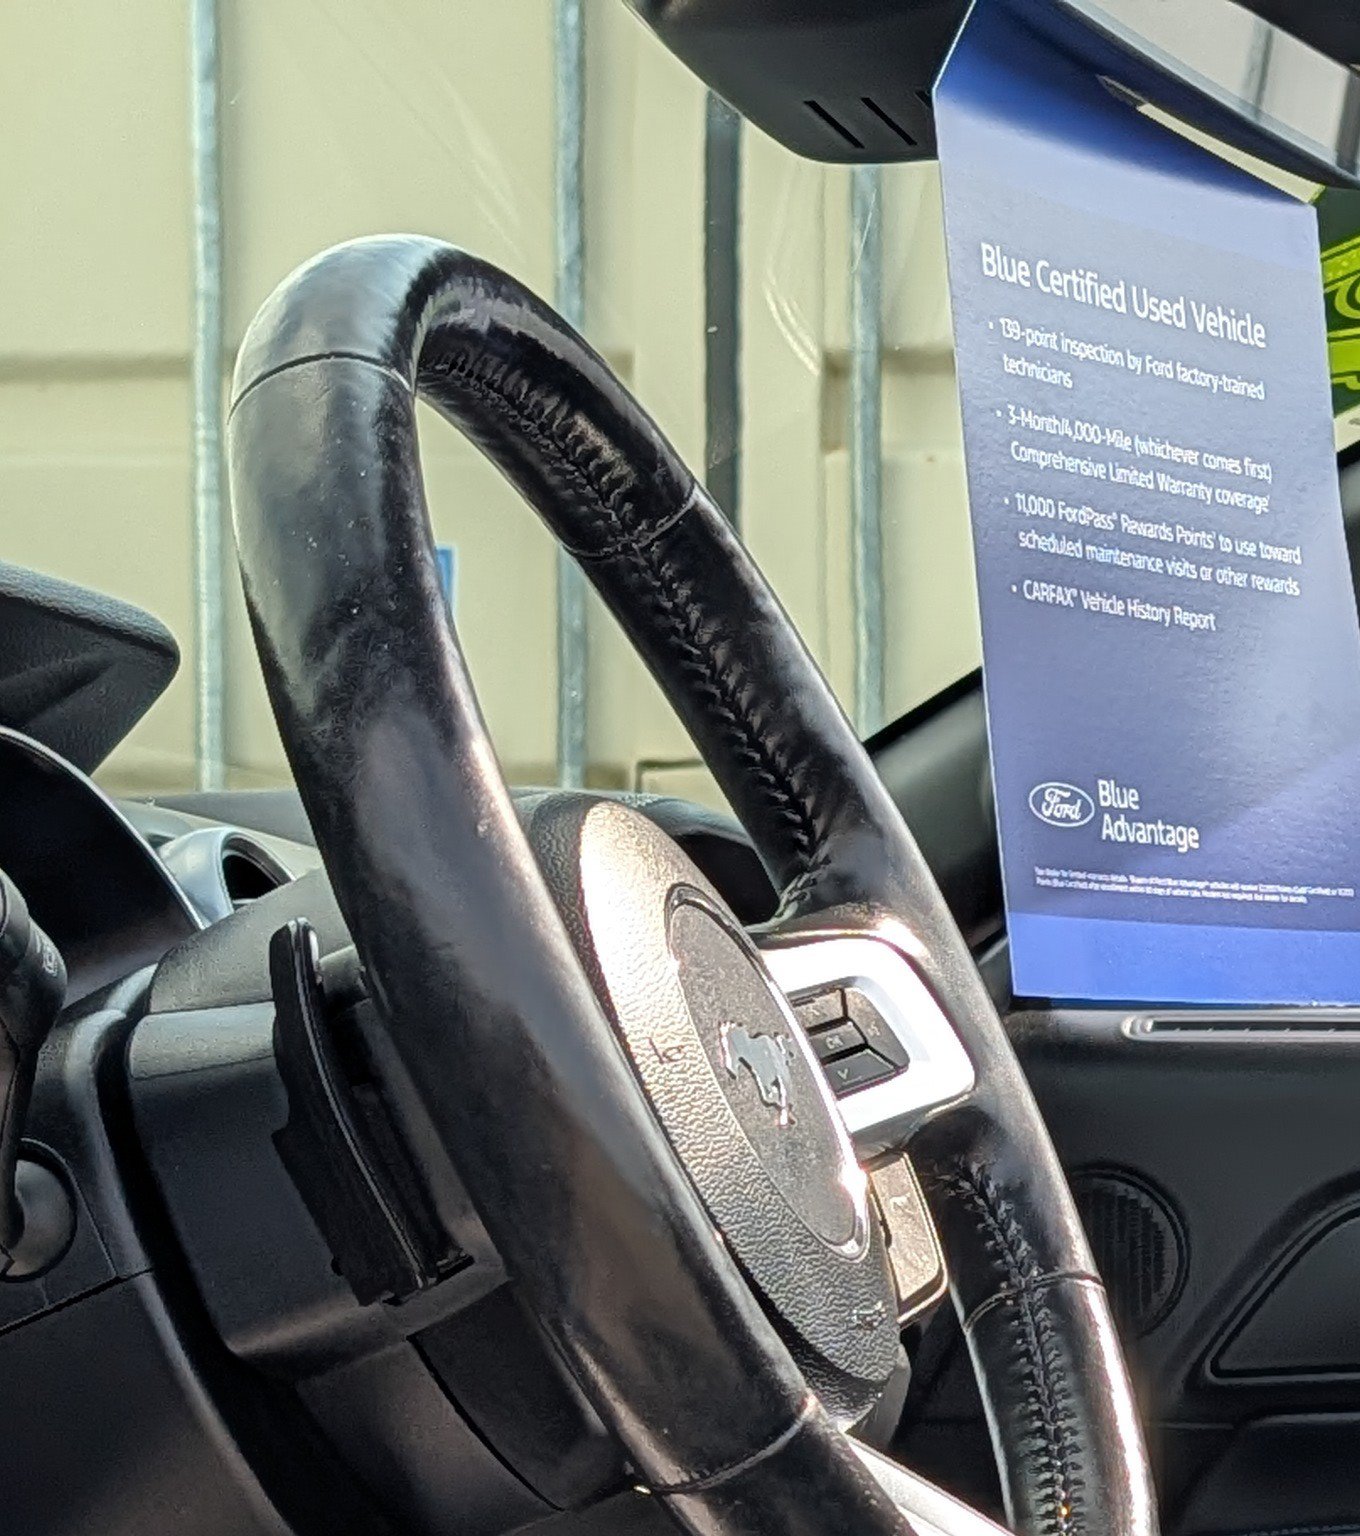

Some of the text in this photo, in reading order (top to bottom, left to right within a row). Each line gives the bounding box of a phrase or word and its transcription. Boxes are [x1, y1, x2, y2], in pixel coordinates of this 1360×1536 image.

[981, 242, 1267, 348] Blue Certified Used Vehicle
[999, 317, 1265, 400] 139-point inspection by Ford factory-trained
[1002, 353, 1073, 389] technicians
[1011, 440, 1107, 482] Comprehensive
[1109, 461, 1155, 490] Limited
[1157, 473, 1213, 505] Warranty
[1134, 434, 1200, 467] (whichever
[1203, 451, 1242, 476] comes
[1244, 456, 1273, 485] first)
[1015, 493, 1056, 519] 11,000
[1120, 515, 1174, 543] Rewards
[1218, 533, 1232, 551] to
[1234, 538, 1257, 558] use
[1259, 542, 1302, 565] toward
[1018, 530, 1301, 597] scheduled maintenance visits or other rewards
[1080, 588, 1125, 617] Vehicle
[1127, 598, 1171, 627] History
[1173, 605, 1216, 632] Report
[1041, 786, 1082, 822] Ford
[1097, 779, 1140, 811] Blue
[1101, 813, 1200, 853] Advantage
